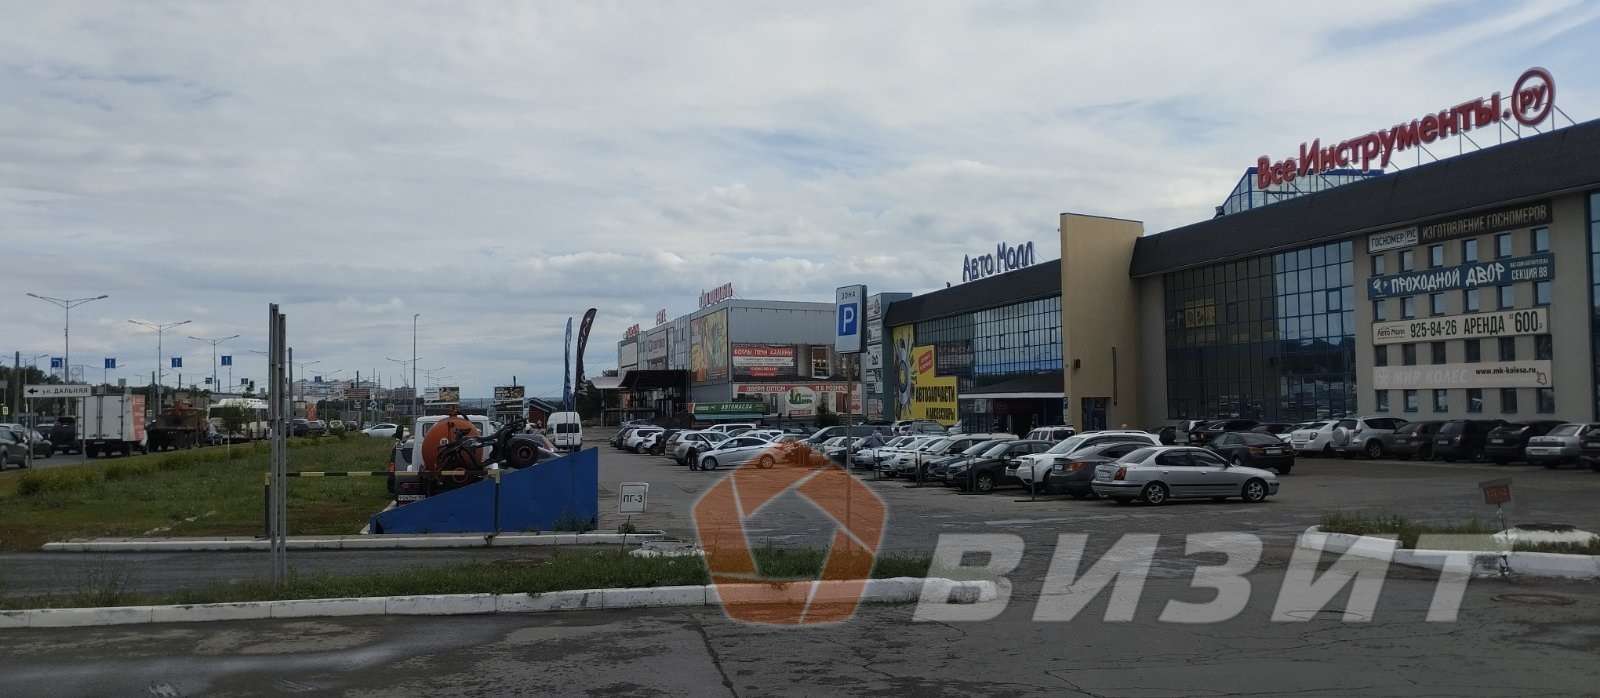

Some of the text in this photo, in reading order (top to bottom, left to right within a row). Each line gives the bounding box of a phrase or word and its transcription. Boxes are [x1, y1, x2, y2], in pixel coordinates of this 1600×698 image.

[1422, 204, 1547, 239] ИЗГОТОВЛЕНИЕ ГОСНОМЕРОВ
[1391, 269, 1460, 293] ПРОХОДНОЙ
[1465, 262, 1505, 286] ДВОР
[1511, 267, 1538, 280] СЕКЦИЯ
[1410, 310, 1539, 338] 925-84-26 АРЕНДА 600
[623, 494, 643, 503] ПГ-3
